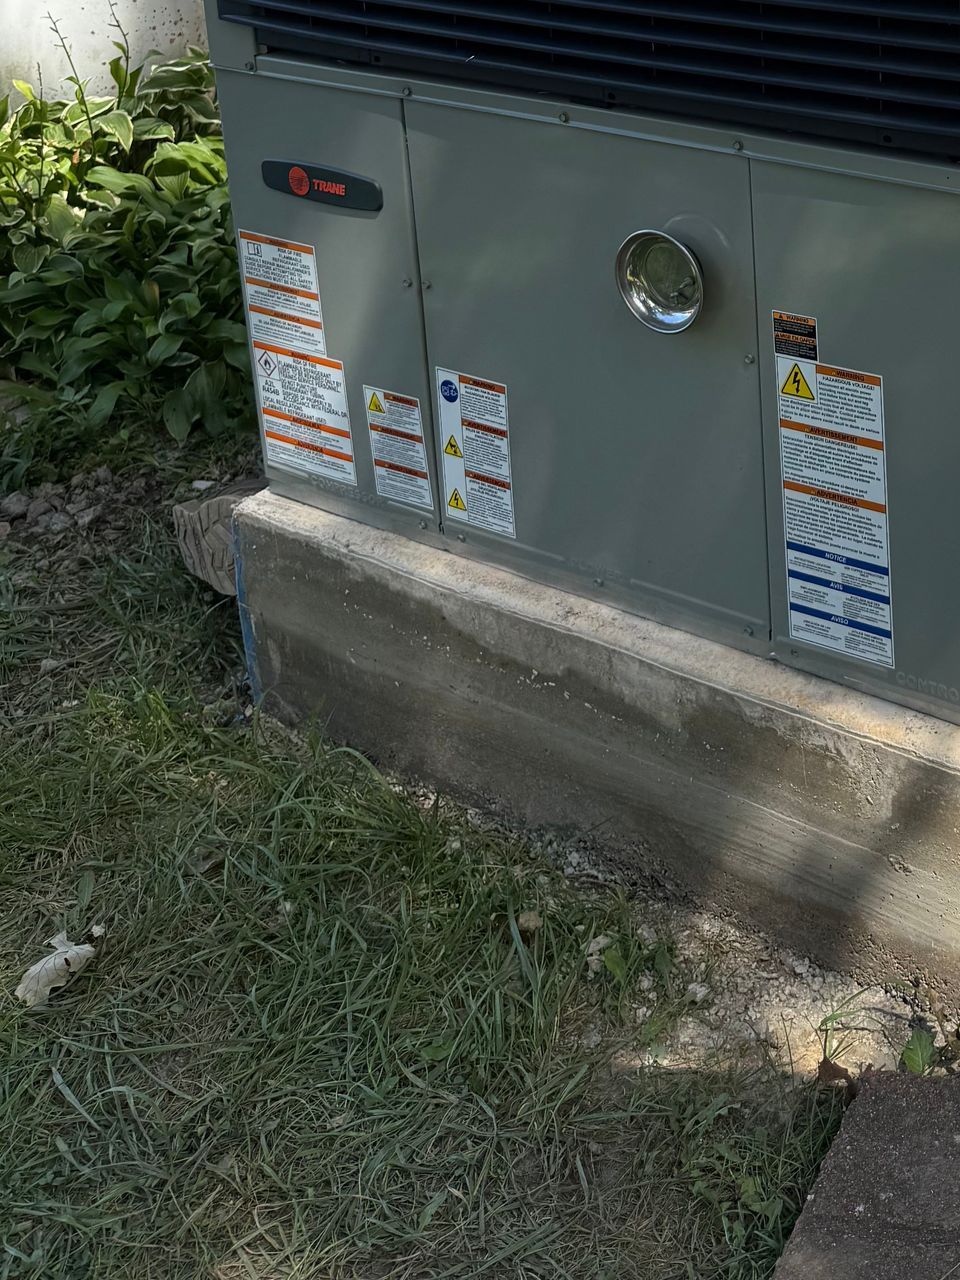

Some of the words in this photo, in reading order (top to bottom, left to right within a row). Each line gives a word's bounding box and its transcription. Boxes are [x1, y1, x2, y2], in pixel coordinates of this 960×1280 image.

[312, 179, 346, 196] TRANE
[822, 376, 851, 386] HAZARDOUS
[836, 370, 865, 382] WARNING
[810, 427, 858, 443] AVERTISSEMENT
[816, 489, 858, 505] ADVERTENCIA
[824, 552, 847, 564] NOTICE
[829, 581, 843, 591] AVIS
[830, 615, 849, 626] AVISO
